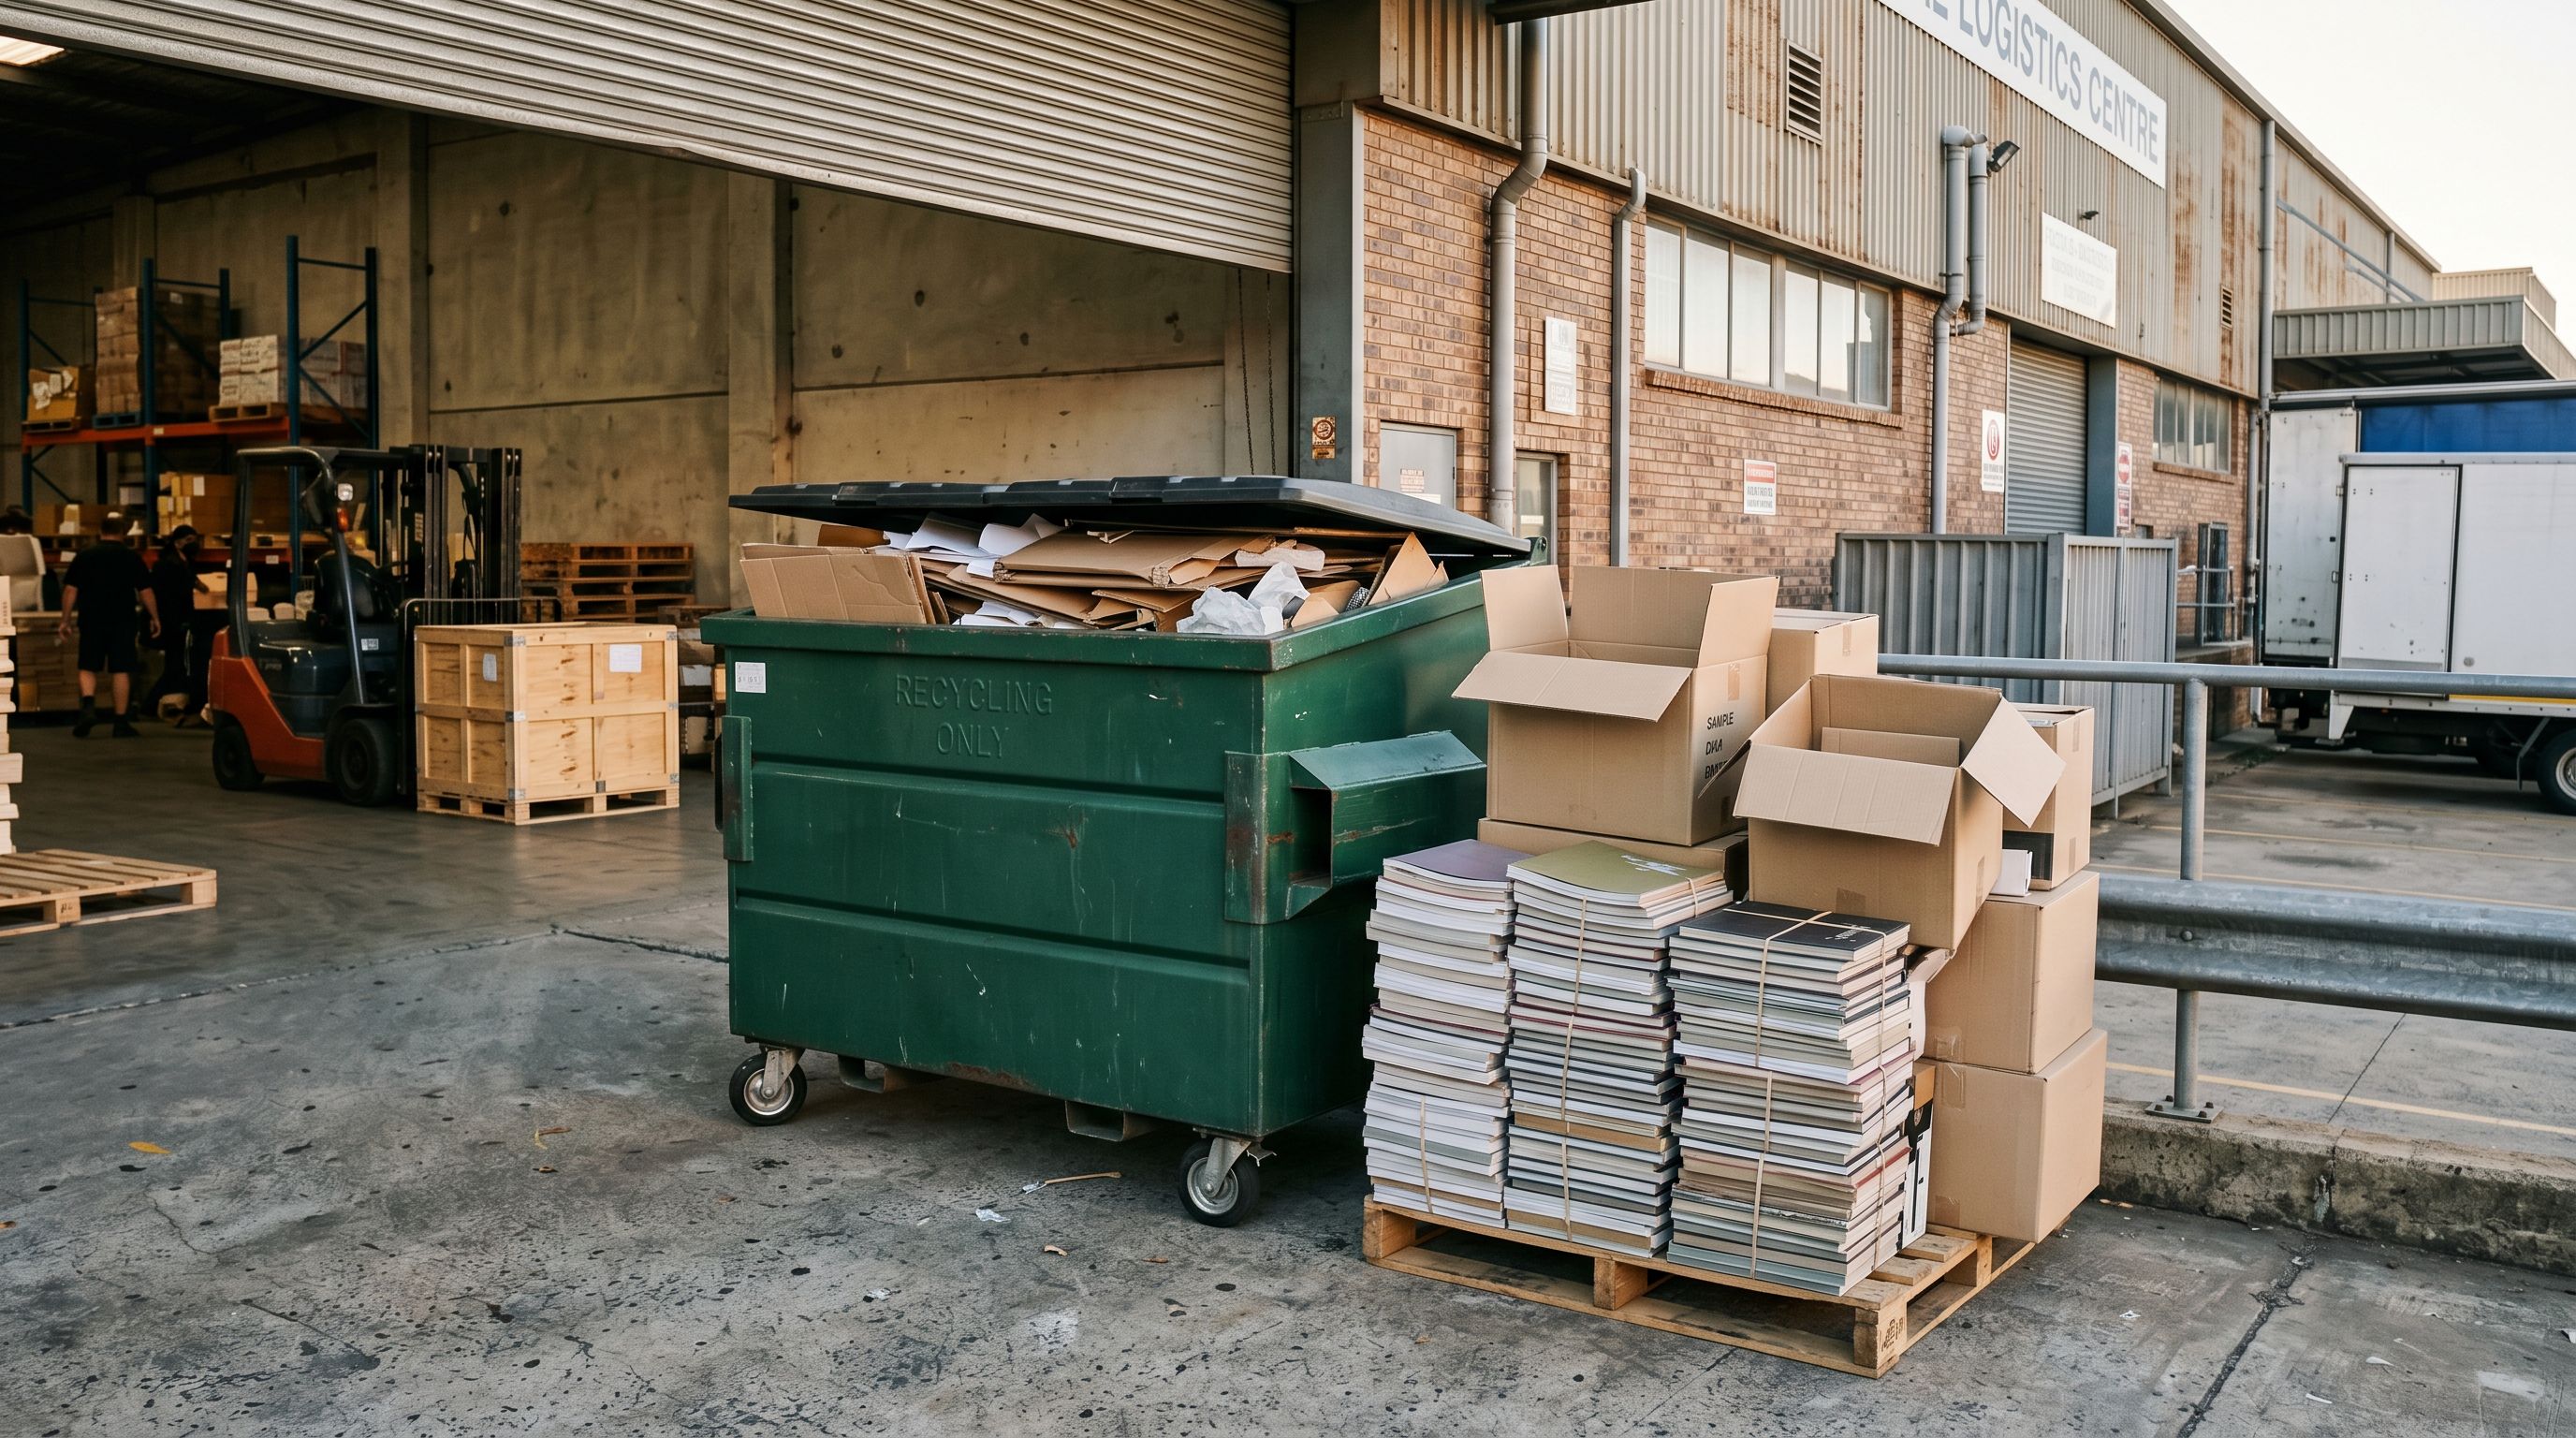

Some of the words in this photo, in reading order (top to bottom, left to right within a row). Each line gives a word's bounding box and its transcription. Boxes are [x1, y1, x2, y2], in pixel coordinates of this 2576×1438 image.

[1959, 0, 2082, 110] LOGISTICS
[2089, 67, 2158, 165] CENTRE
[896, 674, 1052, 714] RECYCLING
[937, 722, 1008, 757] ONLY
